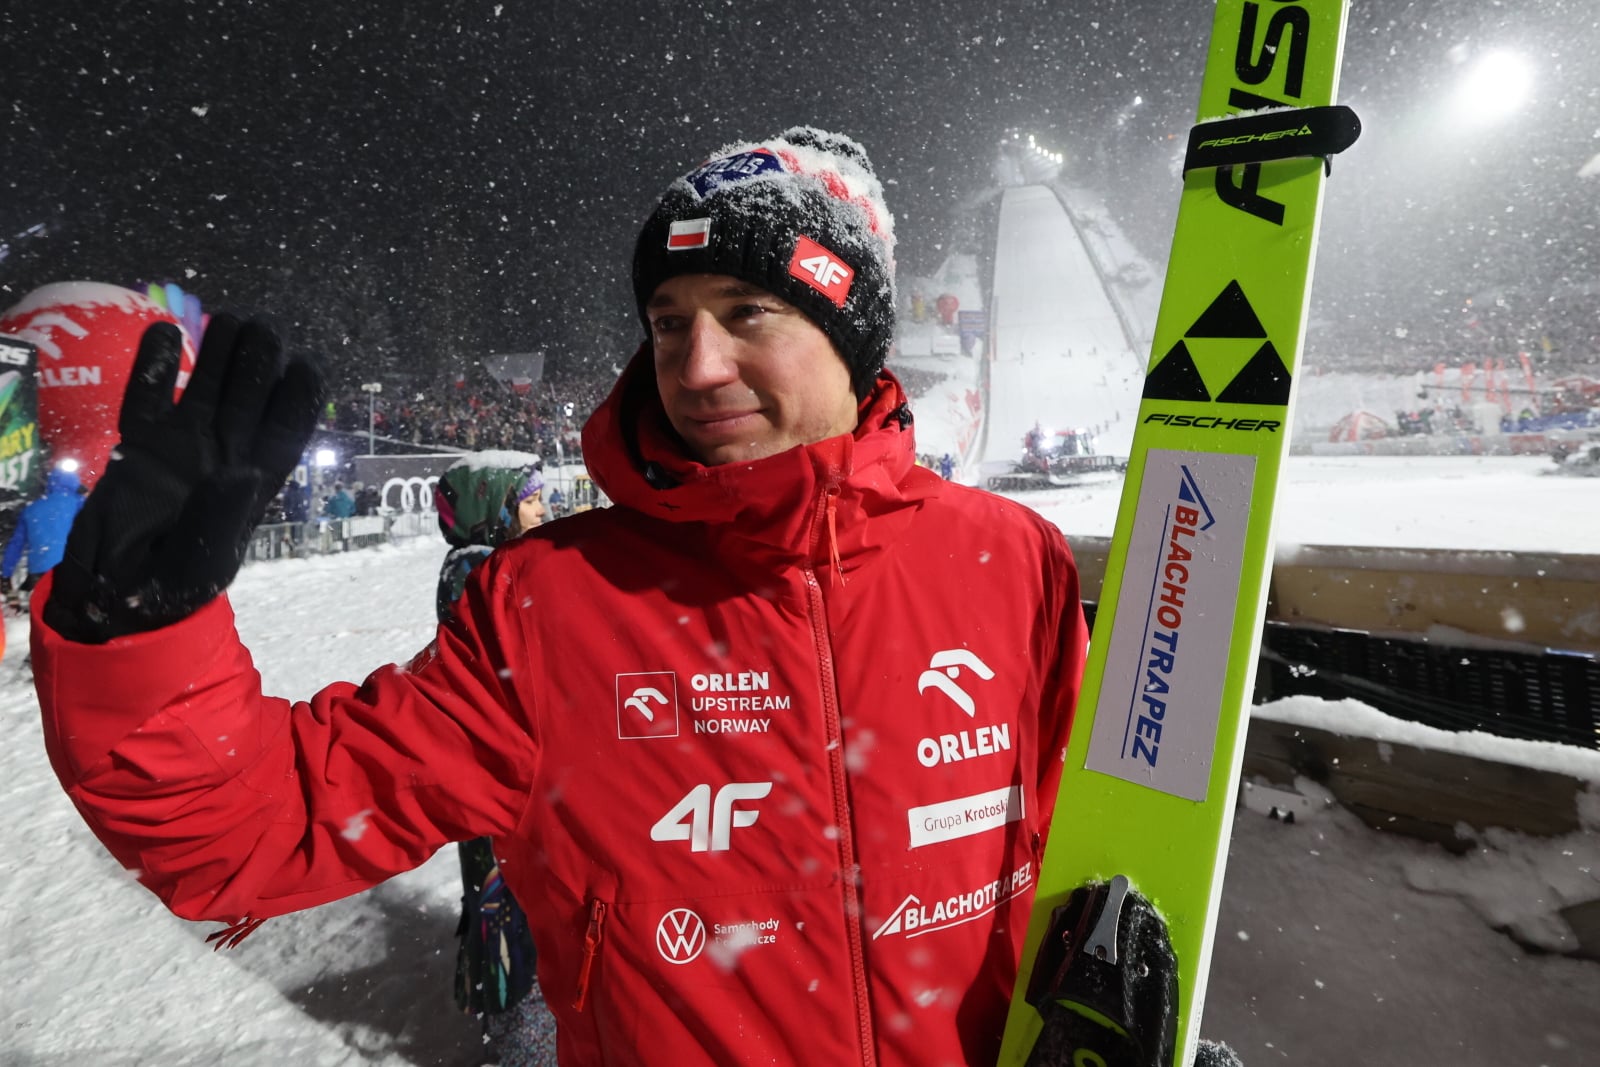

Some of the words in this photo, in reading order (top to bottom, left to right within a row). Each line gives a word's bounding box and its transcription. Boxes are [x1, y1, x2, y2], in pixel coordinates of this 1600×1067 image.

[1215, 0, 1311, 226] FIS
[1198, 128, 1299, 149] FISCHER
[799, 255, 849, 288] 4F
[38, 366, 101, 388] LEN
[1144, 413, 1281, 433] FISCHER
[1131, 504, 1200, 768] BLACHOTRAPEZ
[691, 671, 769, 692] ORLEN
[691, 695, 791, 712] UPSTREAM
[694, 718, 771, 734] NORWAY
[917, 722, 1011, 768] ORLEN
[650, 781, 773, 852] 4F
[924, 814, 962, 831] Grupa
[964, 798, 1008, 823] Krotoski
[904, 861, 1033, 931] BLACHOTRAPEZ
